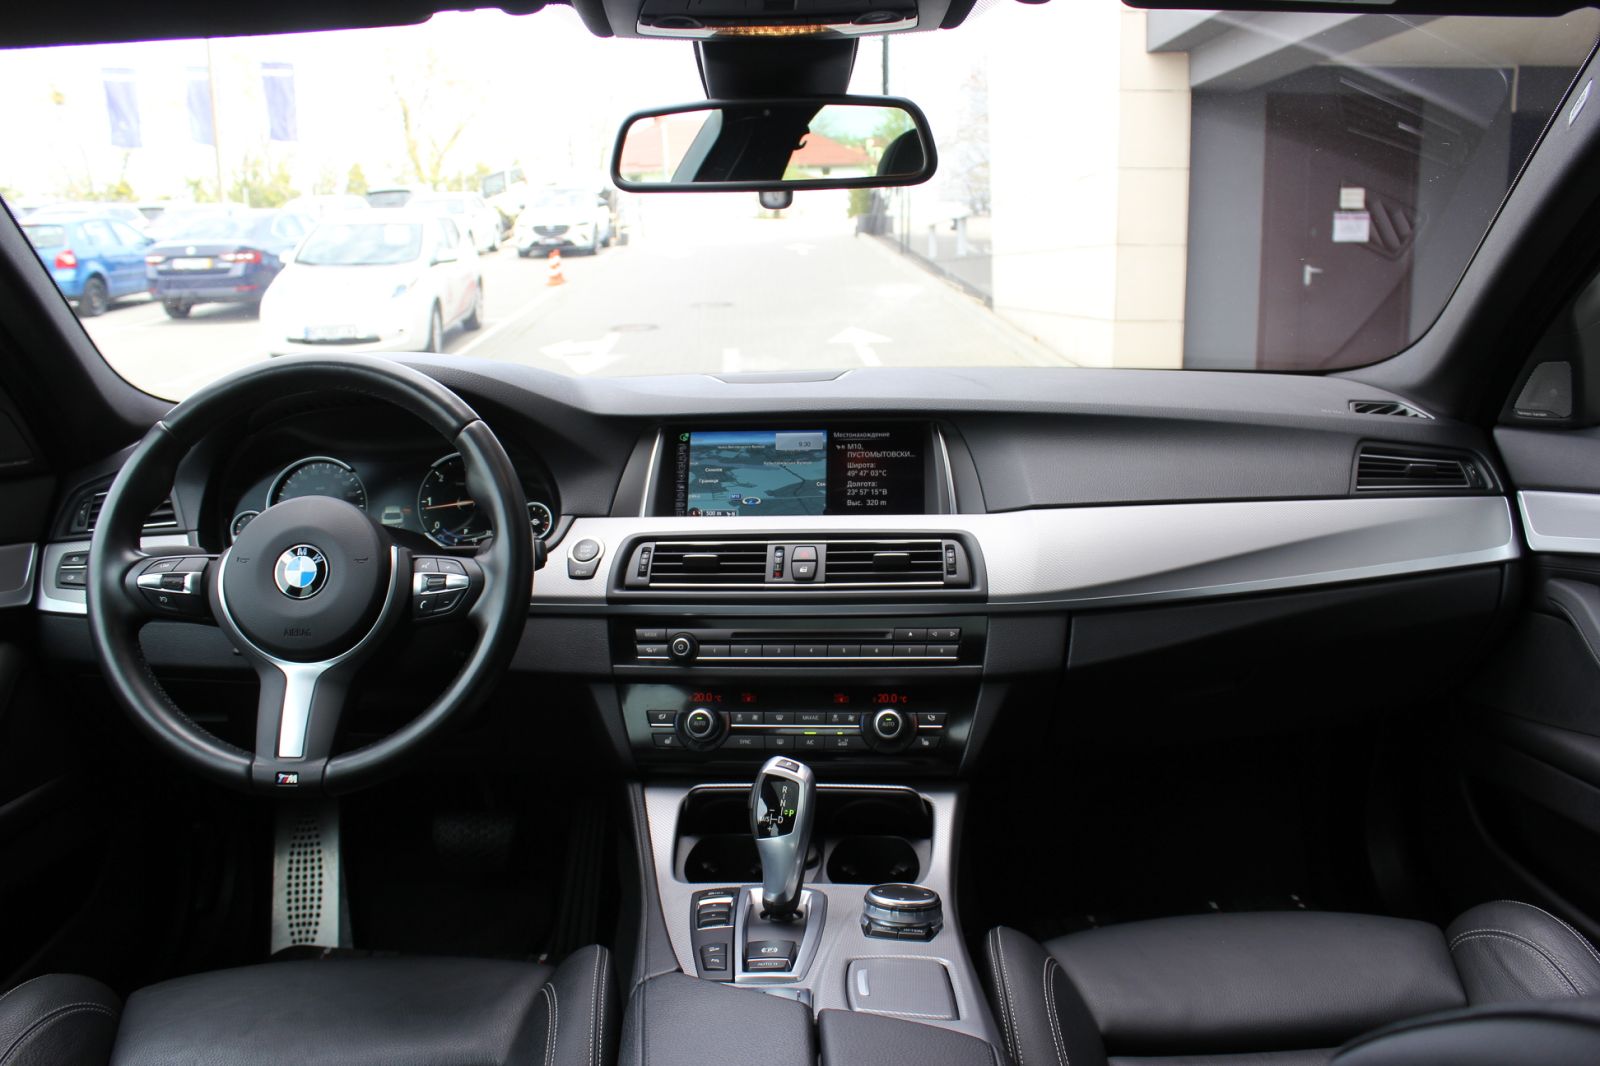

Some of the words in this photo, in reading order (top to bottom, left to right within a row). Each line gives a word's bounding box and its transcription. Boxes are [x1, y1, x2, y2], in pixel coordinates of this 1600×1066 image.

[847, 480, 878, 488] Долгота:
[426, 497, 432, 506] 1
[434, 521, 441, 529] 0
[878, 693, 898, 703] 20.0
[782, 785, 788, 793] R
[780, 799, 786, 807] N
[777, 815, 784, 824] D
